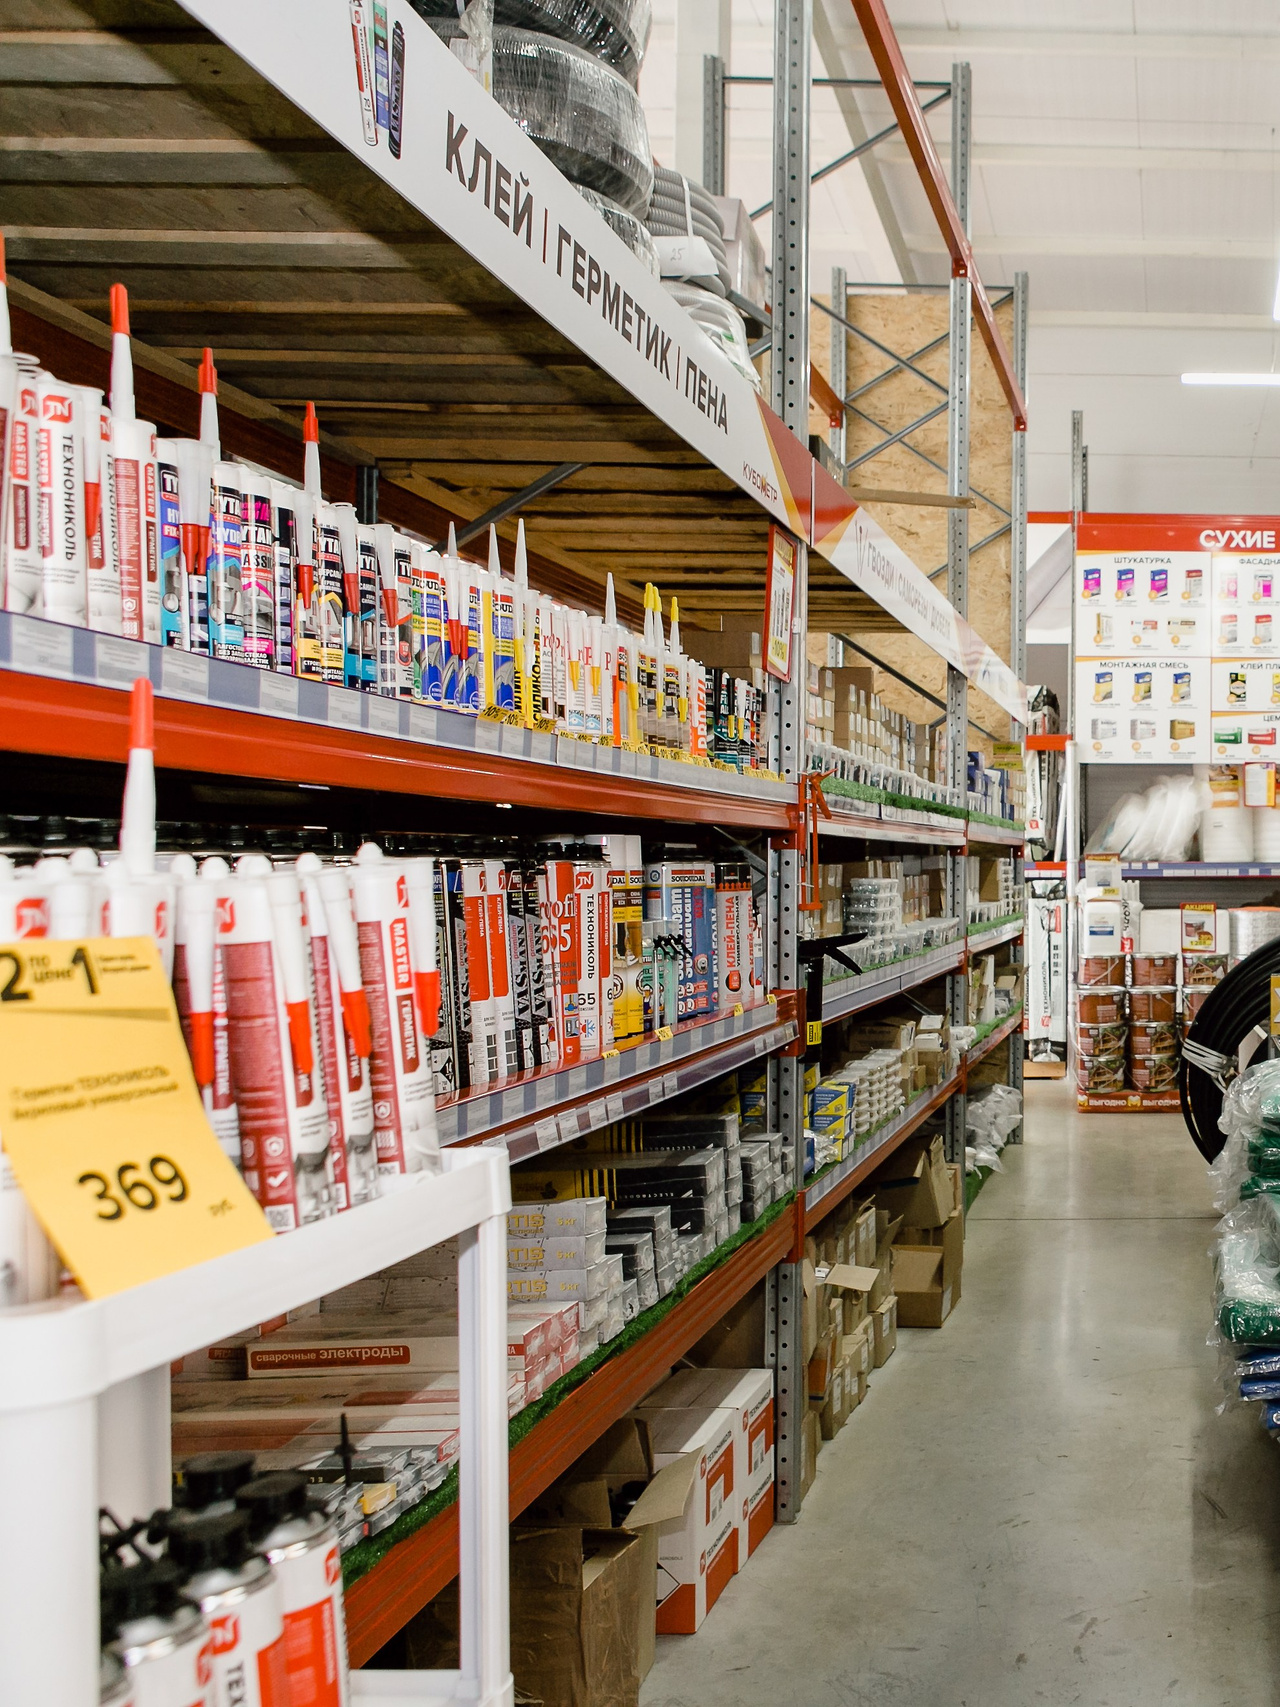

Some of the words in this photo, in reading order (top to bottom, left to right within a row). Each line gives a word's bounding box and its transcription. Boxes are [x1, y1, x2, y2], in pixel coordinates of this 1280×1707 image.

[446, 110, 534, 249] КЛЕЙ
[556, 223, 671, 382] ГЕРМЕТИК
[685, 356, 729, 435] ПЕНА
[15, 424, 28, 478] MASTER
[62, 434, 77, 561] ТЕХНОНИКОЛЬ
[145, 465, 155, 514] MASTER
[742, 459, 779, 504] КУБОМЕТР
[1200, 529, 1276, 549] СУХИЕ
[1099, 661, 1157, 669] МОНТАЖНАЯ
[1240, 662, 1263, 670] КЛЕЙ
[392, 922, 411, 985] MASTER
[511, 924, 520, 960] premium
[586, 894, 596, 980] ТЕХНОНИКОЛЬ
[723, 896, 735, 968] КЛЕЙ-ПЕНА
[72, 947, 99, 995] 1
[578, 992, 596, 1006] 65
[401, 999, 418, 1061] ГЕРМЕТИК
[77, 1064, 170, 1091] ТЕХНОНИКОЛЬ
[78, 1154, 190, 1221] 369
[256, 1352, 316, 1363] сварочные
[319, 1346, 404, 1361] электроды
[706, 1430, 732, 1465] ТЕХНОНИКОЛЬ
[706, 1520, 732, 1559] ТЕХНОНИКОЛЬ
